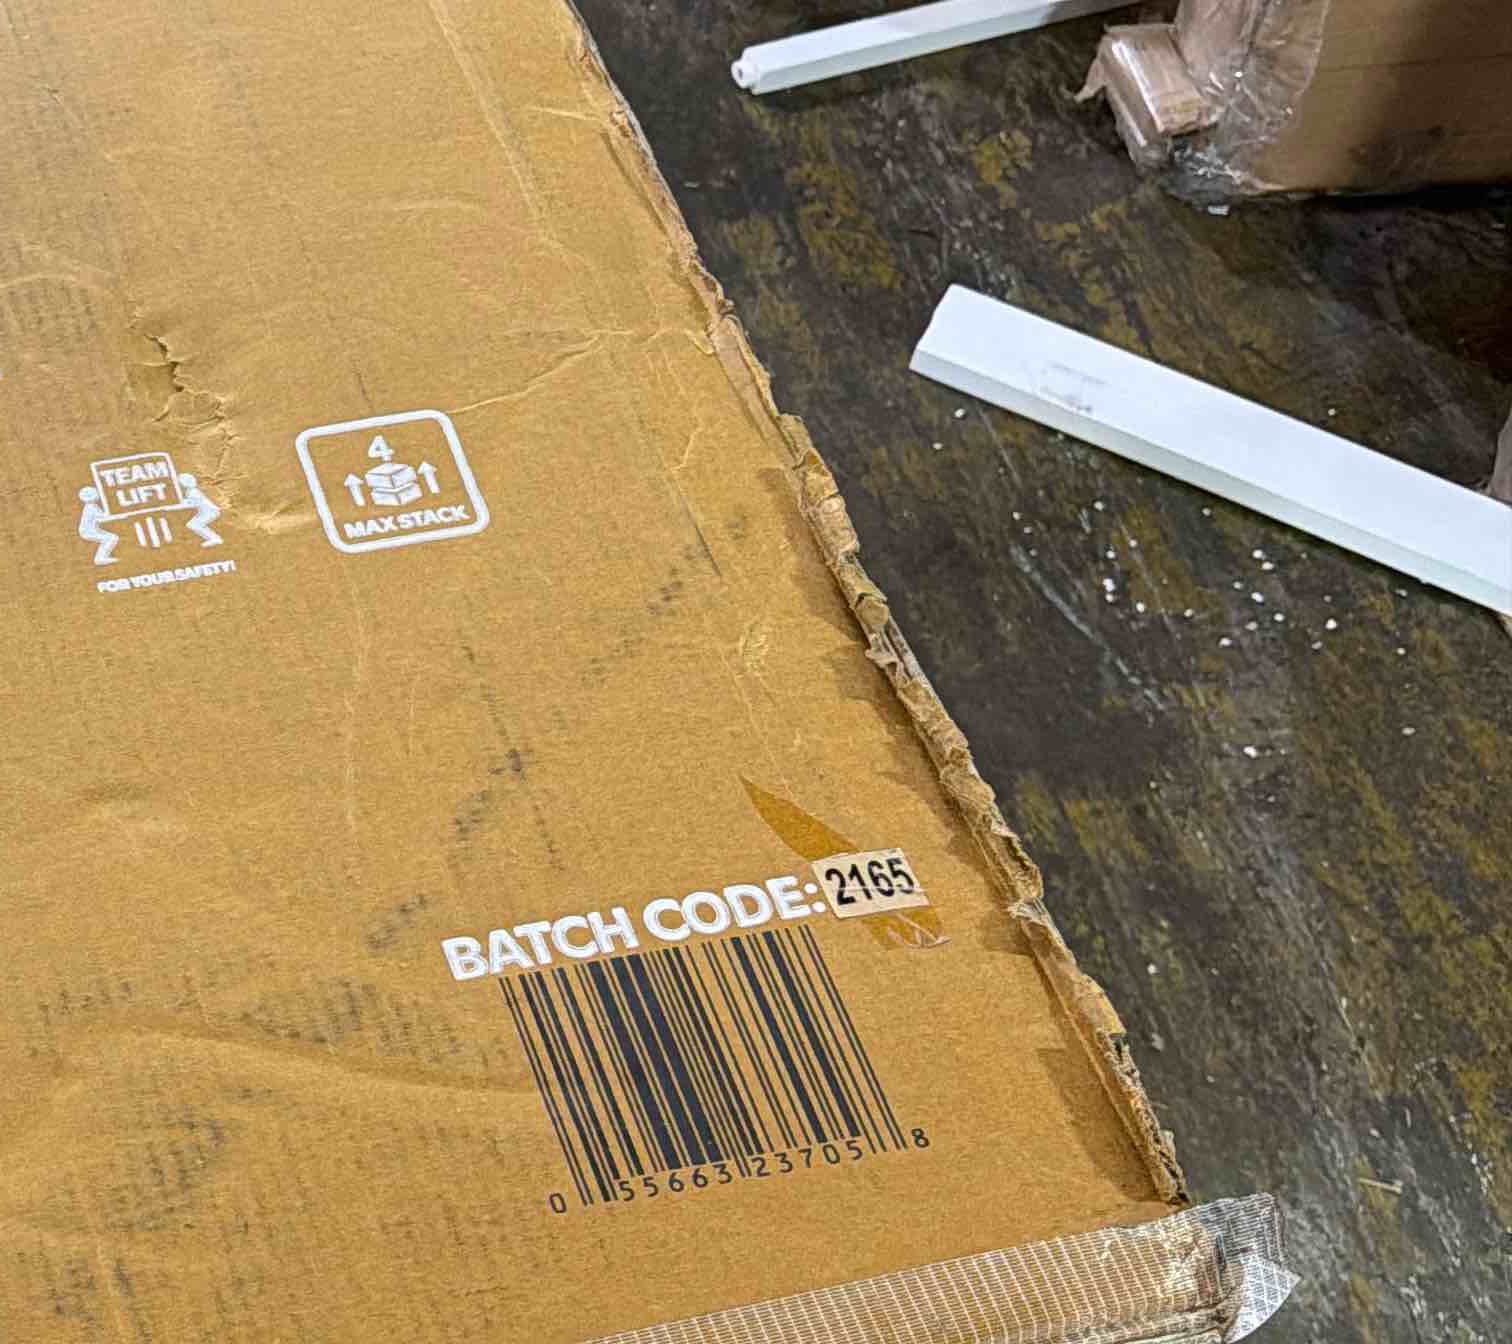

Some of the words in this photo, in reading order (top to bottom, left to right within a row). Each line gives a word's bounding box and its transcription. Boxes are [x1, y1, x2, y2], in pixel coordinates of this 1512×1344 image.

[366, 435, 393, 462] 4
[99, 462, 170, 488] TEAM
[116, 482, 169, 508] LIFT
[343, 515, 397, 540] MAX
[396, 503, 472, 534] STACK
[96, 577, 129, 594] FOR
[128, 569, 174, 591] YOUR
[440, 906, 640, 982] BATCH
[642, 874, 828, 942] CODE:
[824, 855, 918, 907] 2165
[548, 1191, 568, 1215] 0
[617, 1162, 735, 1203] 55663
[751, 1138, 865, 1179] 23705
[910, 1127, 931, 1151] 8
